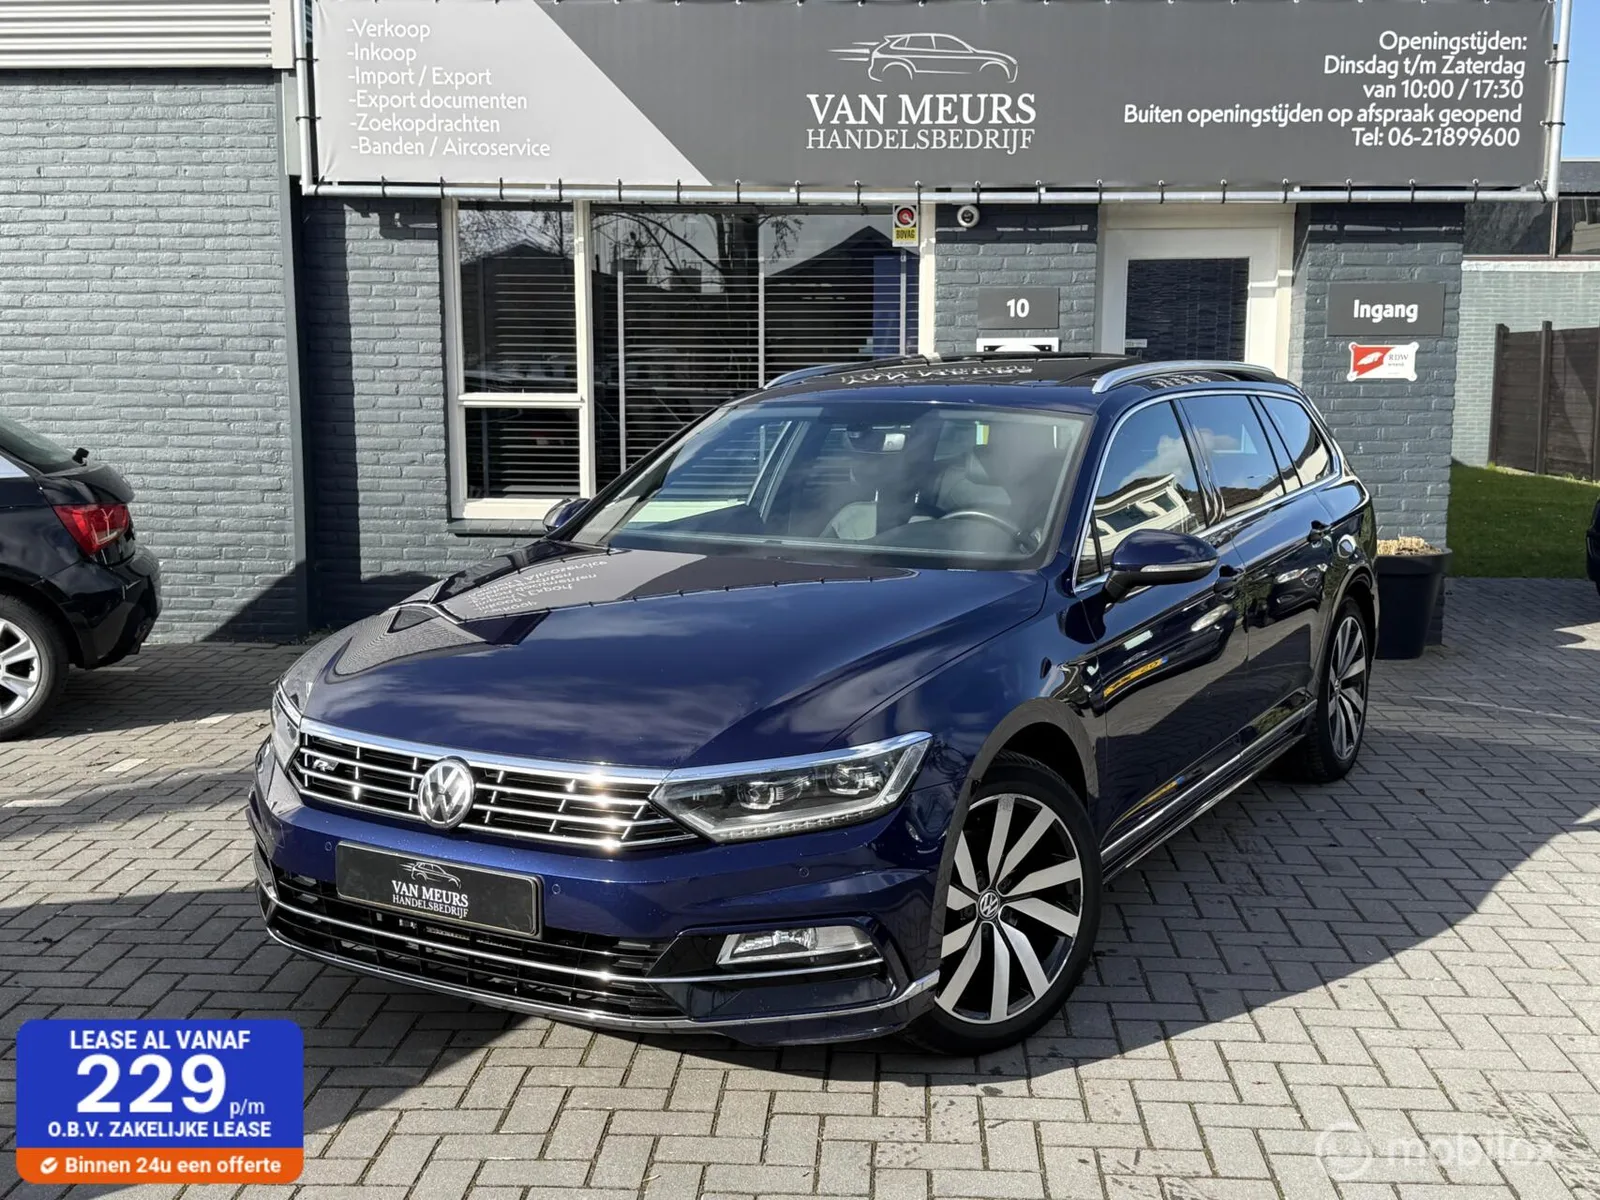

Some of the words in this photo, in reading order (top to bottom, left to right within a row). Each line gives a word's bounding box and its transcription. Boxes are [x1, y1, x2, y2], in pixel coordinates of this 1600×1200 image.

[347, 19, 430, 41] -Verkoop
[1379, 30, 1527, 53] Openingstijden:
[347, 43, 416, 65] -Inkoop
[348, 66, 414, 89] -Import
[419, 66, 427, 86] /
[432, 67, 492, 89] Export
[1324, 55, 1399, 78] Dinsdag
[1403, 56, 1436, 76] t/m
[1441, 55, 1525, 78] Zaterdag
[1363, 83, 1396, 98] van
[1401, 80, 1454, 98] 10:00
[1458, 79, 1468, 100] /
[1473, 79, 1523, 98] 17:30
[349, 90, 416, 112] -Export
[420, 91, 527, 109] documenten
[806, 94, 887, 124] VAN
[898, 93, 1036, 124] MEURS
[350, 113, 500, 135] -Zoekopdrachten
[1124, 105, 1182, 123] Buiten
[1187, 105, 1323, 127] openingstijden
[1327, 109, 1353, 126] op
[1357, 105, 1434, 126] afspraak
[1438, 105, 1522, 127] geopend
[351, 137, 424, 155] -Banden
[430, 136, 438, 157] /
[443, 138, 550, 157] Aircoservice
[806, 129, 1035, 154] HANDELSBEDRIJF
[1352, 128, 1382, 146] Tel:
[1387, 128, 1520, 146] 06-21899600
[895, 229, 916, 239] BOVAG
[1007, 299, 1030, 317] 10
[1353, 299, 1419, 323] Ingang
[392, 880, 418, 897] VAN
[422, 886, 469, 907] MEURS
[392, 894, 469, 918] HANDELSBEDRIJF
